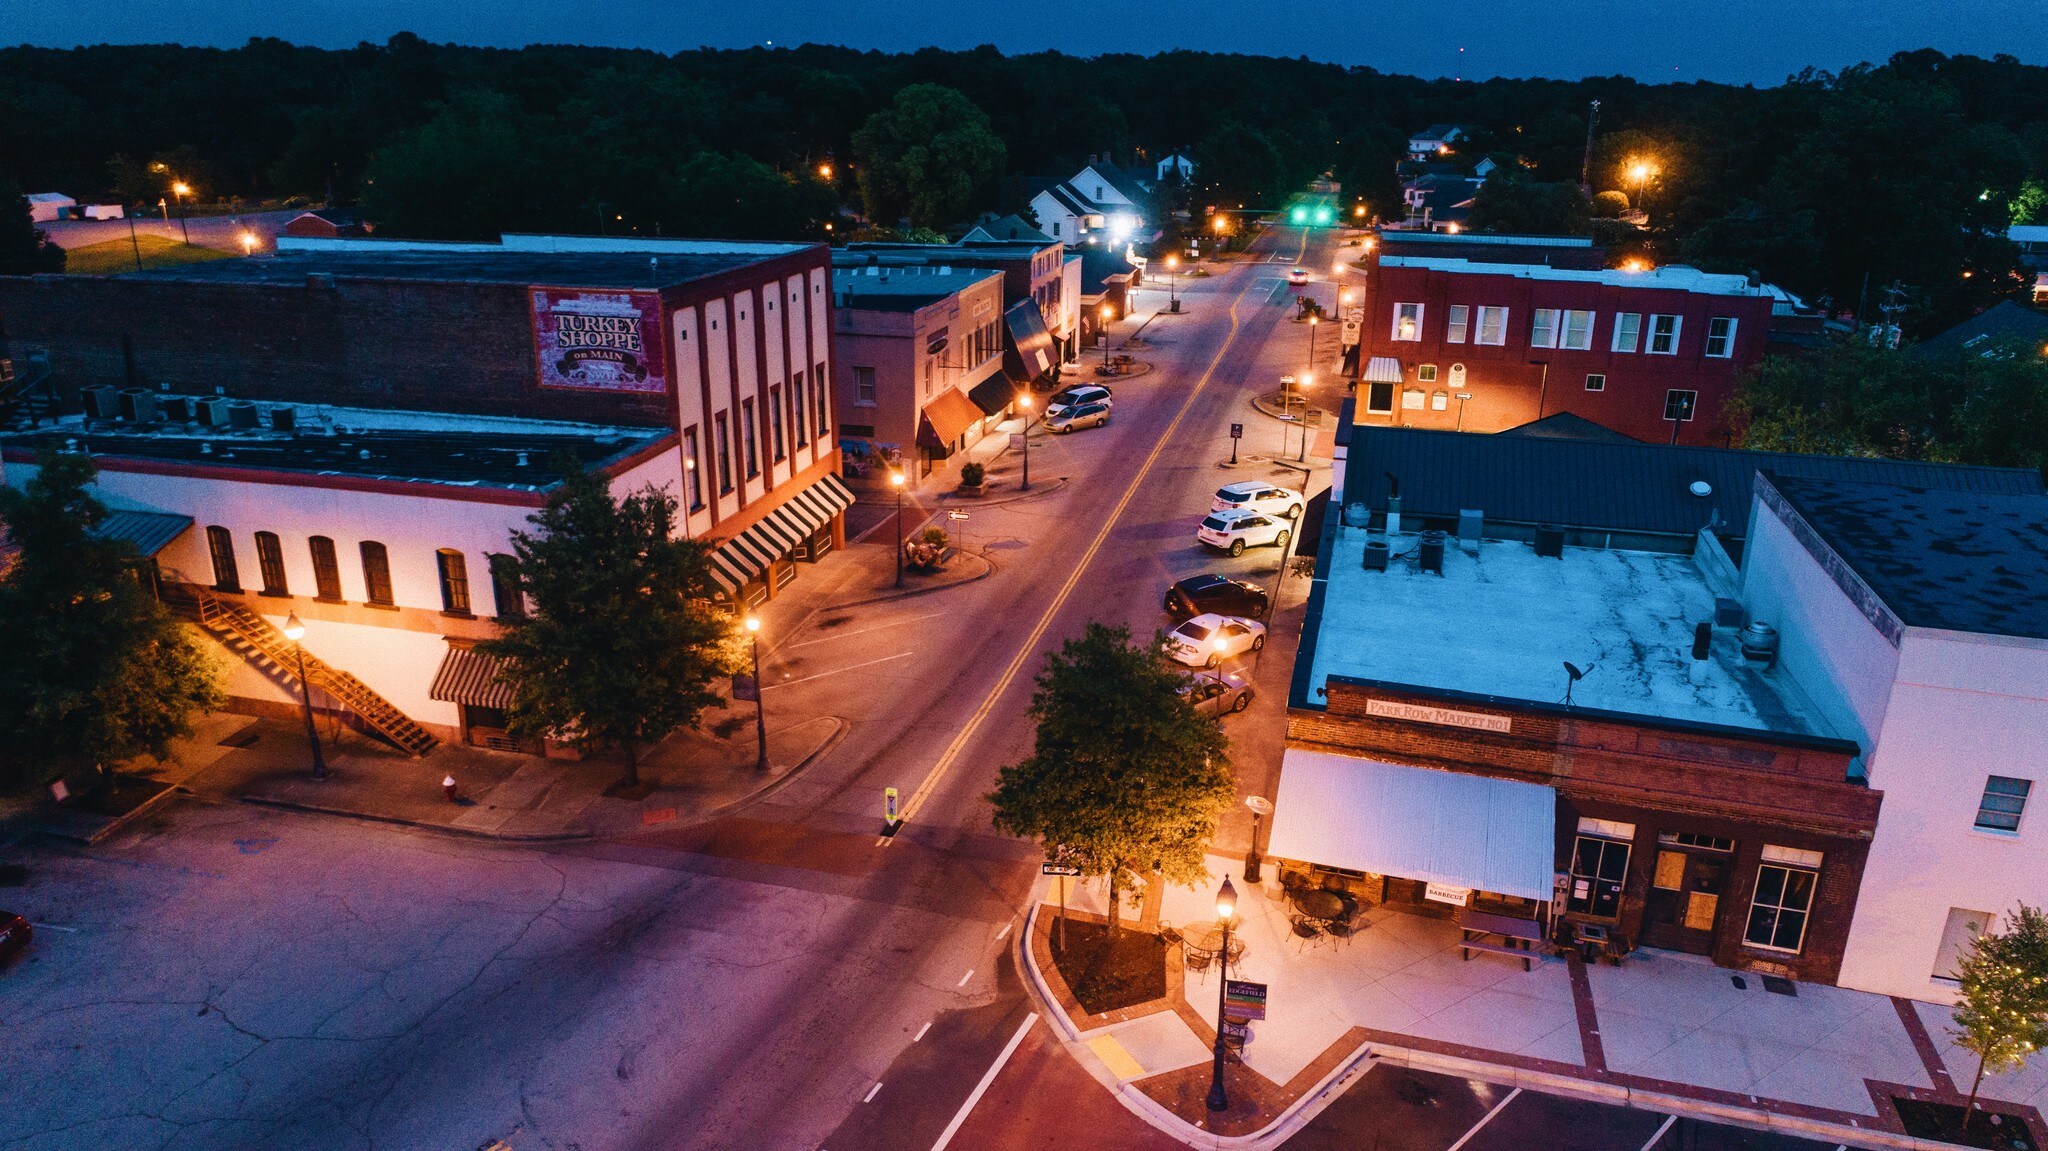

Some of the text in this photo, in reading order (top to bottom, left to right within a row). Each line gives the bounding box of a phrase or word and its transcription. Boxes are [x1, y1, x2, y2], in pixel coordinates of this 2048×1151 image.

[554, 314, 641, 334] TURKEY
[558, 330, 641, 352] SHOPPE
[590, 350, 624, 362] MAIN
[1428, 889, 1464, 901] BARBECUE
